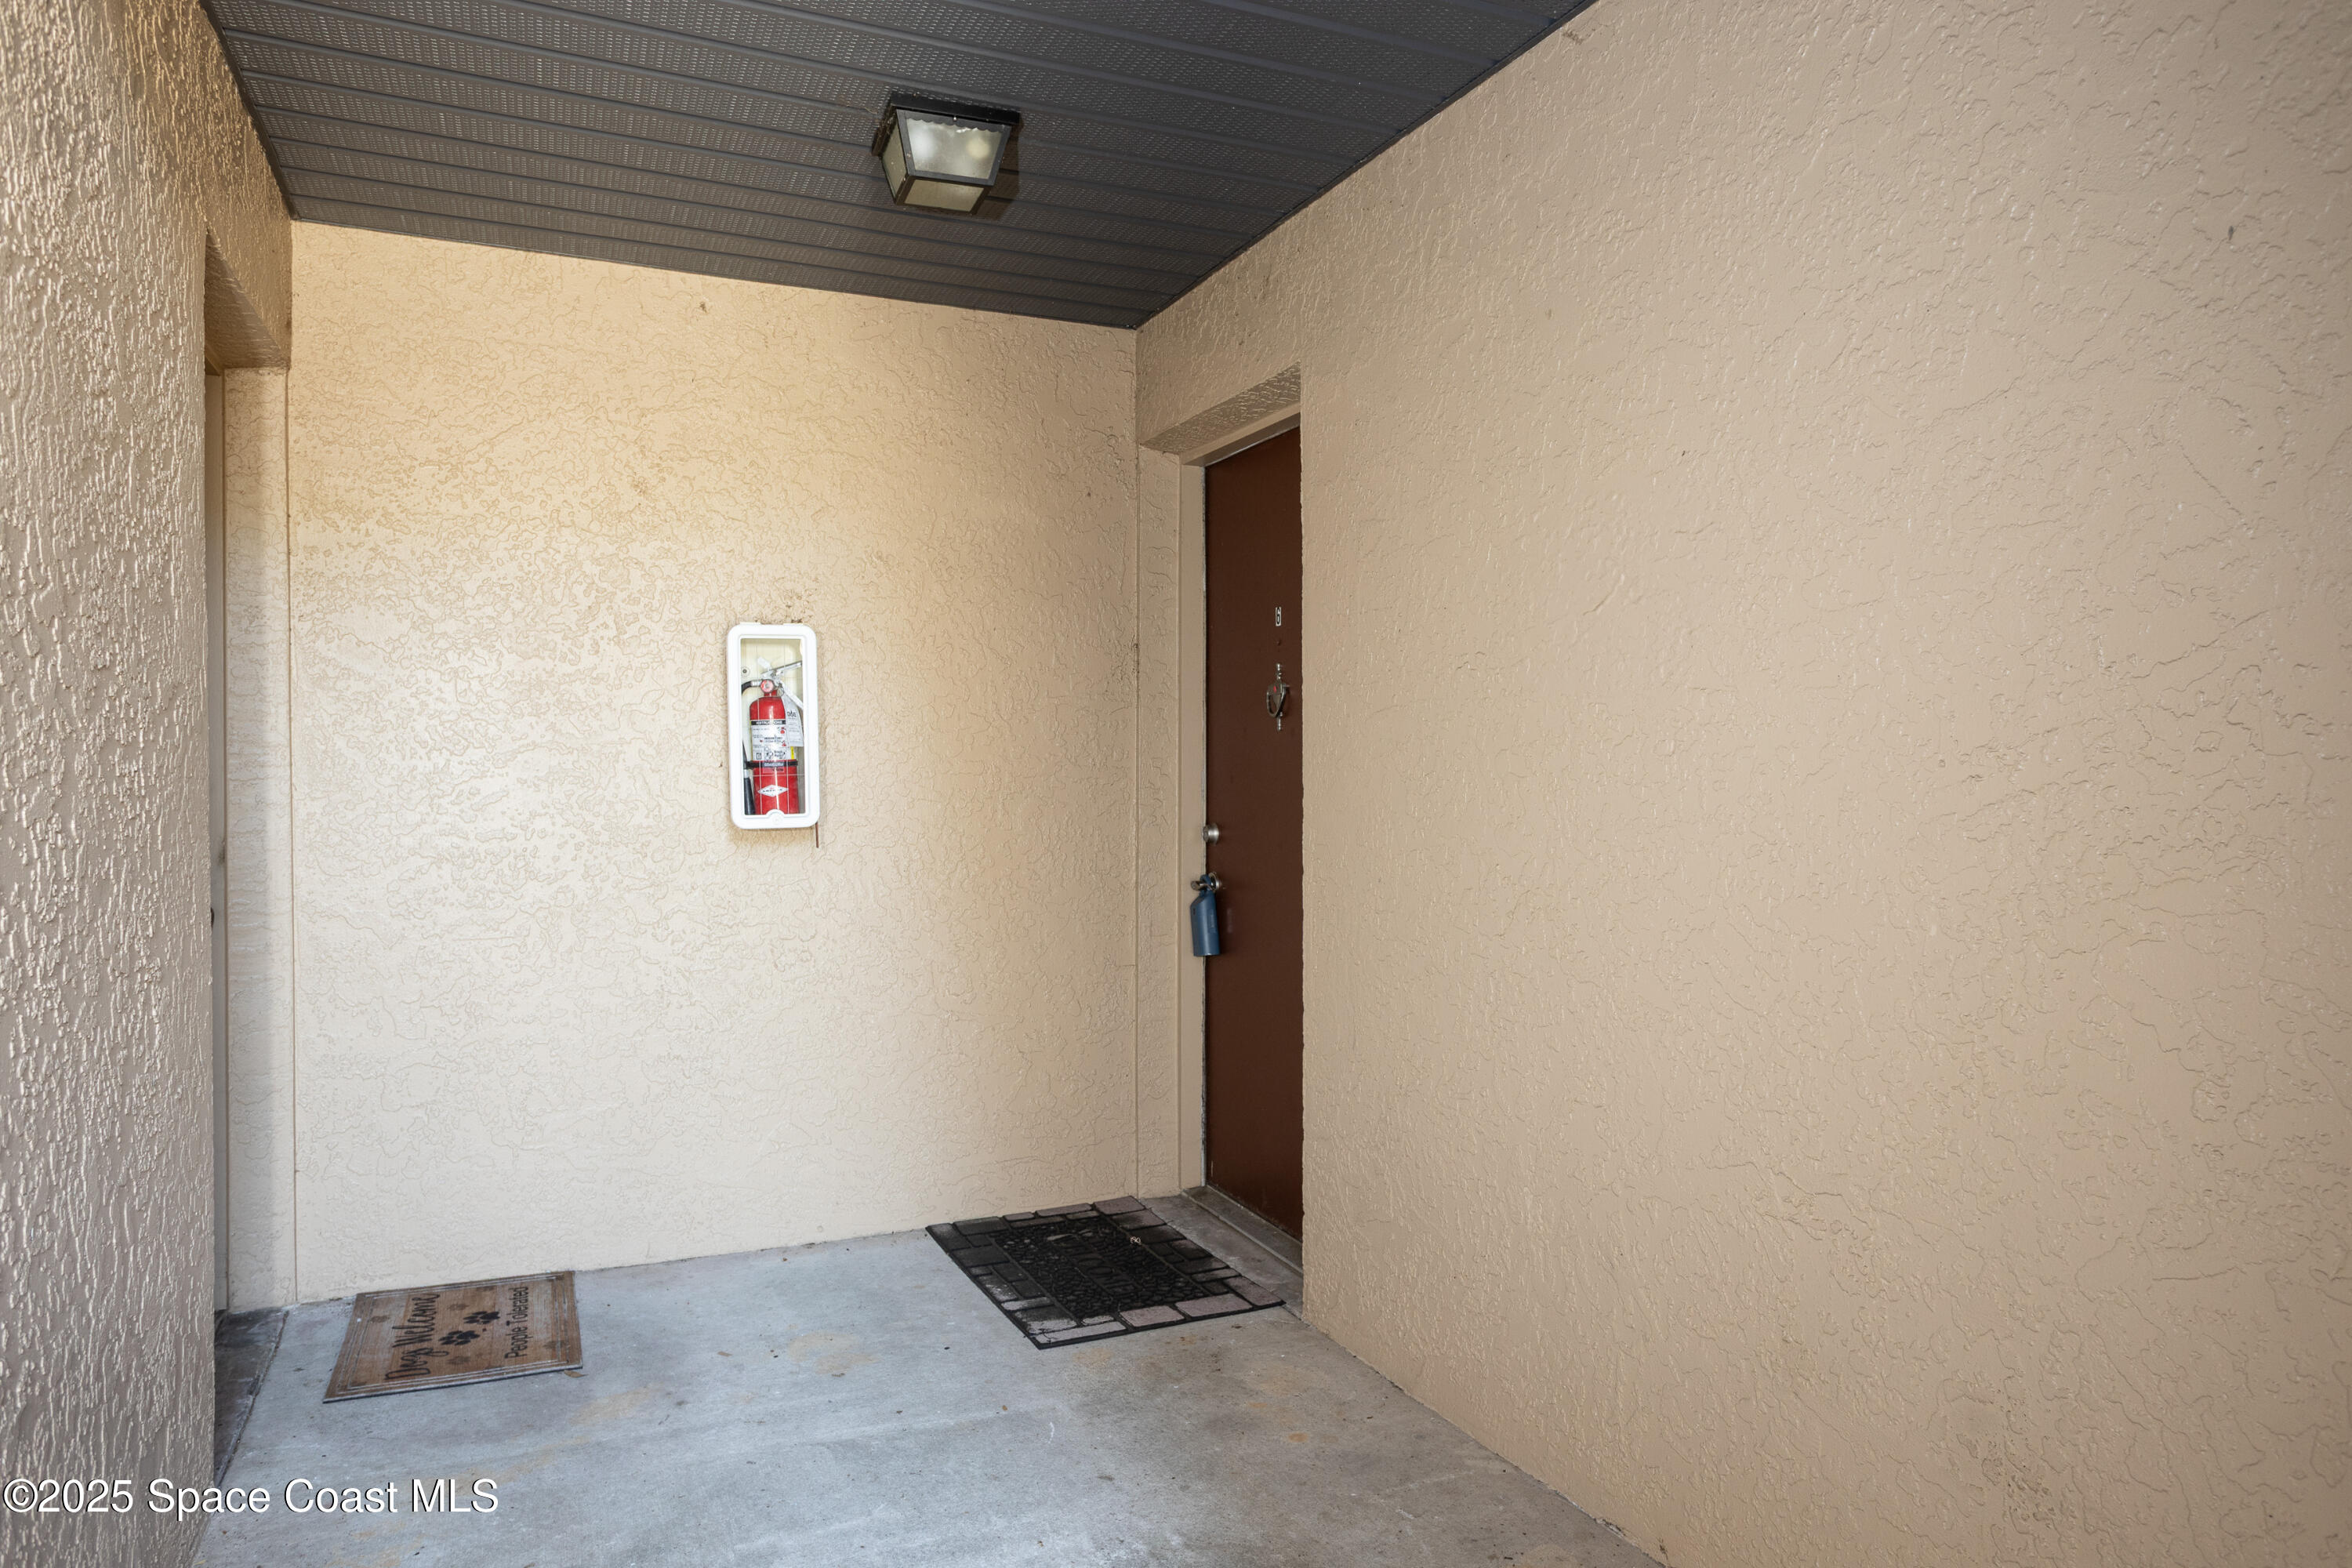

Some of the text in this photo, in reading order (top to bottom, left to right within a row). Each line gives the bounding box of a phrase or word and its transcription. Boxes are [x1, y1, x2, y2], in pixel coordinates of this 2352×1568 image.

[1276, 607, 1281, 626] 6
[384, 1293, 449, 1380] Dogs Welcome
[504, 1287, 533, 1359] People Tolerated
